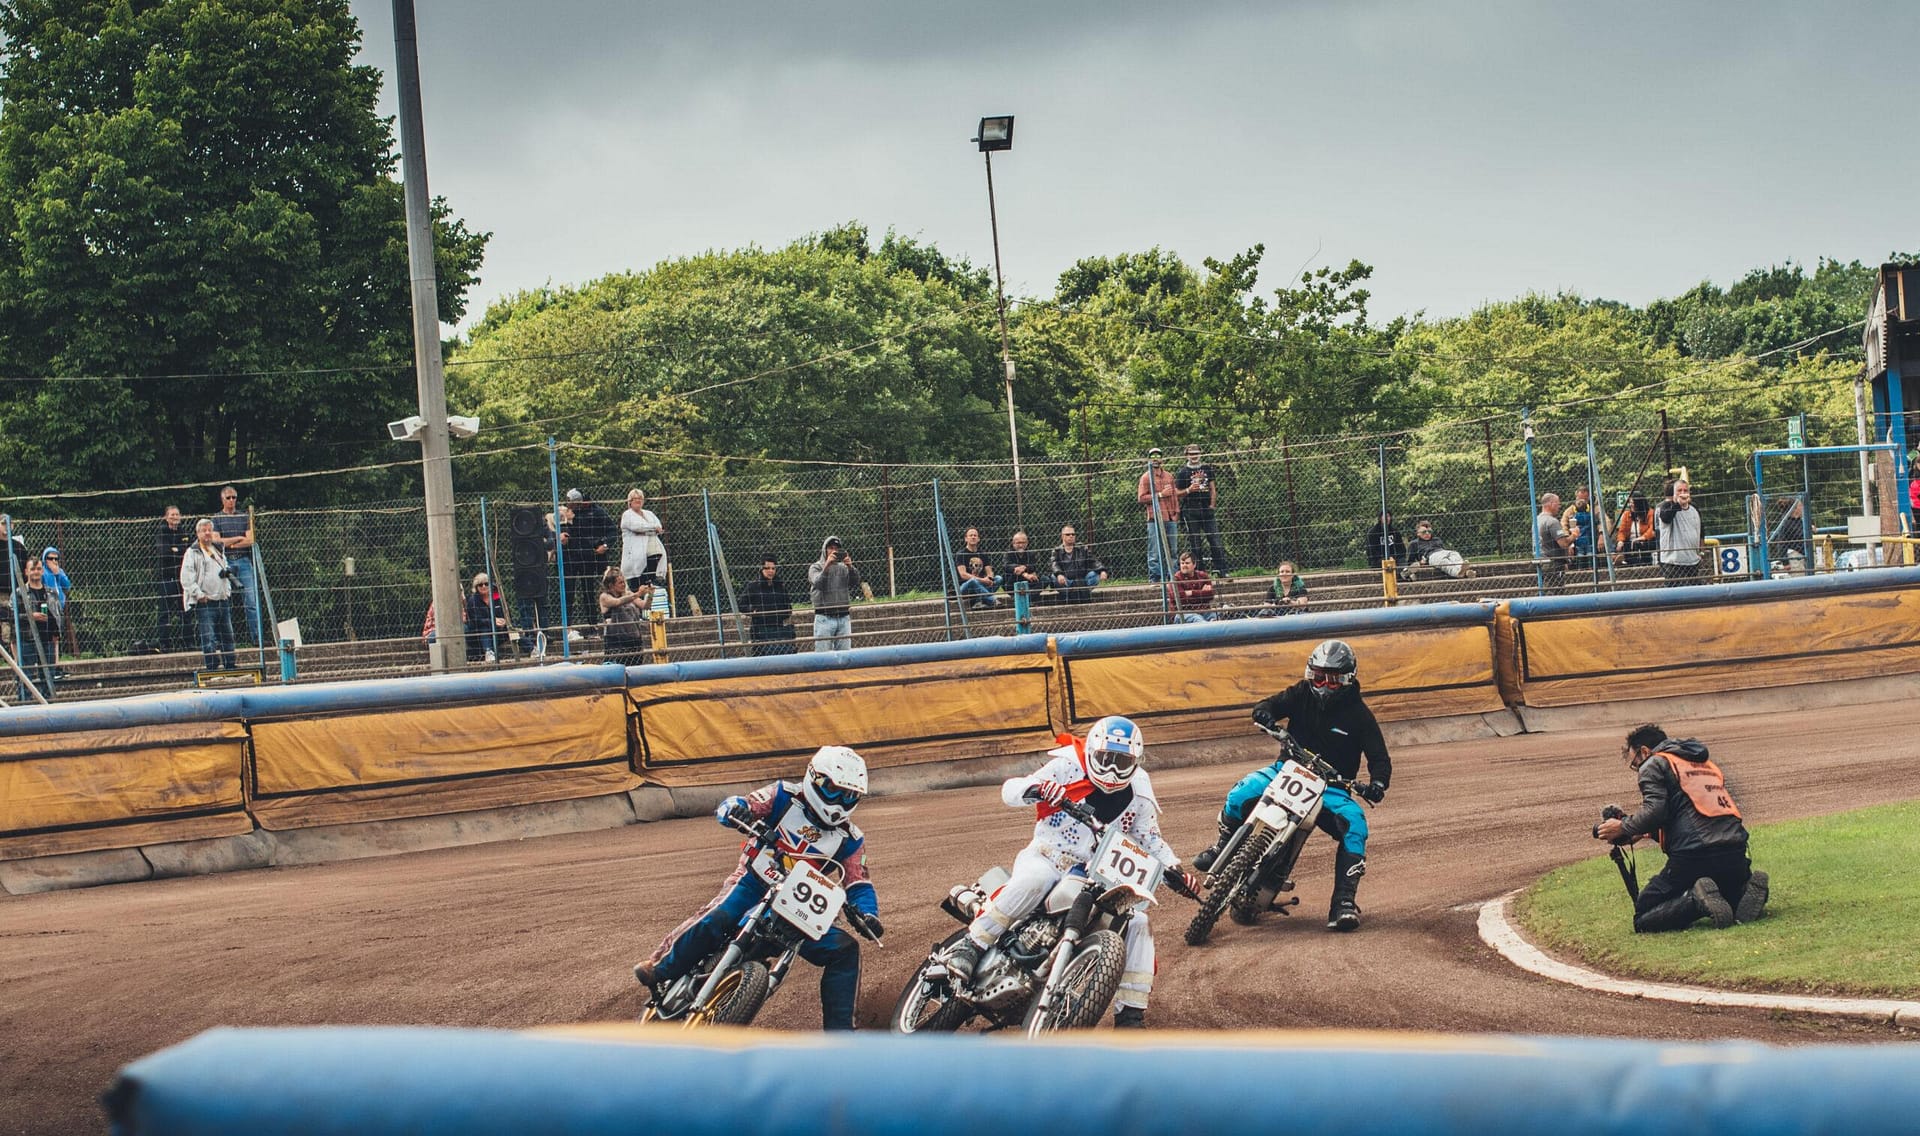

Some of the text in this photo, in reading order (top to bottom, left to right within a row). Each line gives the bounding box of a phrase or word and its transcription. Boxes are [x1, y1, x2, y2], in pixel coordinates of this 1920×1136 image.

[1721, 548, 1740, 573] 8
[1280, 775, 1317, 804] 107
[1110, 849, 1148, 885] 101
[793, 882, 828, 915] 99
[795, 908, 808, 921] 2019
